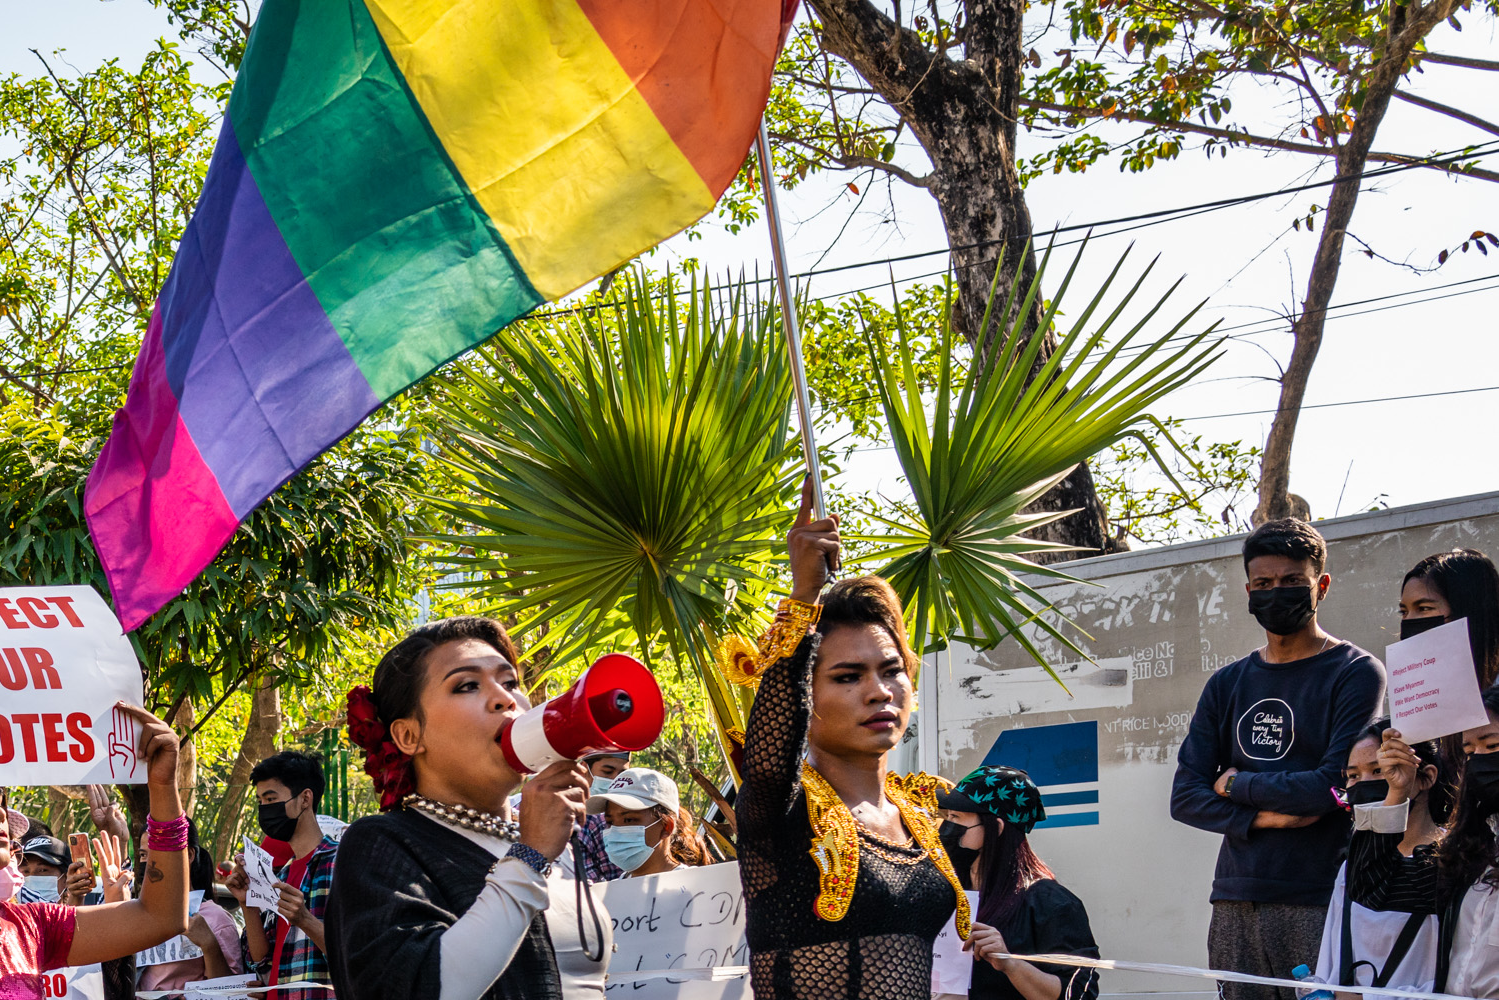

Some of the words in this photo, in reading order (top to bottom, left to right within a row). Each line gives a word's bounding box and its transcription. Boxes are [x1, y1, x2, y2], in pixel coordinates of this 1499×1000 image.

[1423, 657, 1436, 667] Coup
[1405, 680, 1424, 690] Myanmar
[1404, 694, 1415, 703] Want
[1416, 688, 1439, 700] Democracy
[1399, 708, 1415, 719] Respect
[1415, 705, 1424, 715] Our
[1424, 701, 1438, 711] Votes
[1252, 731, 1282, 753] Victory
